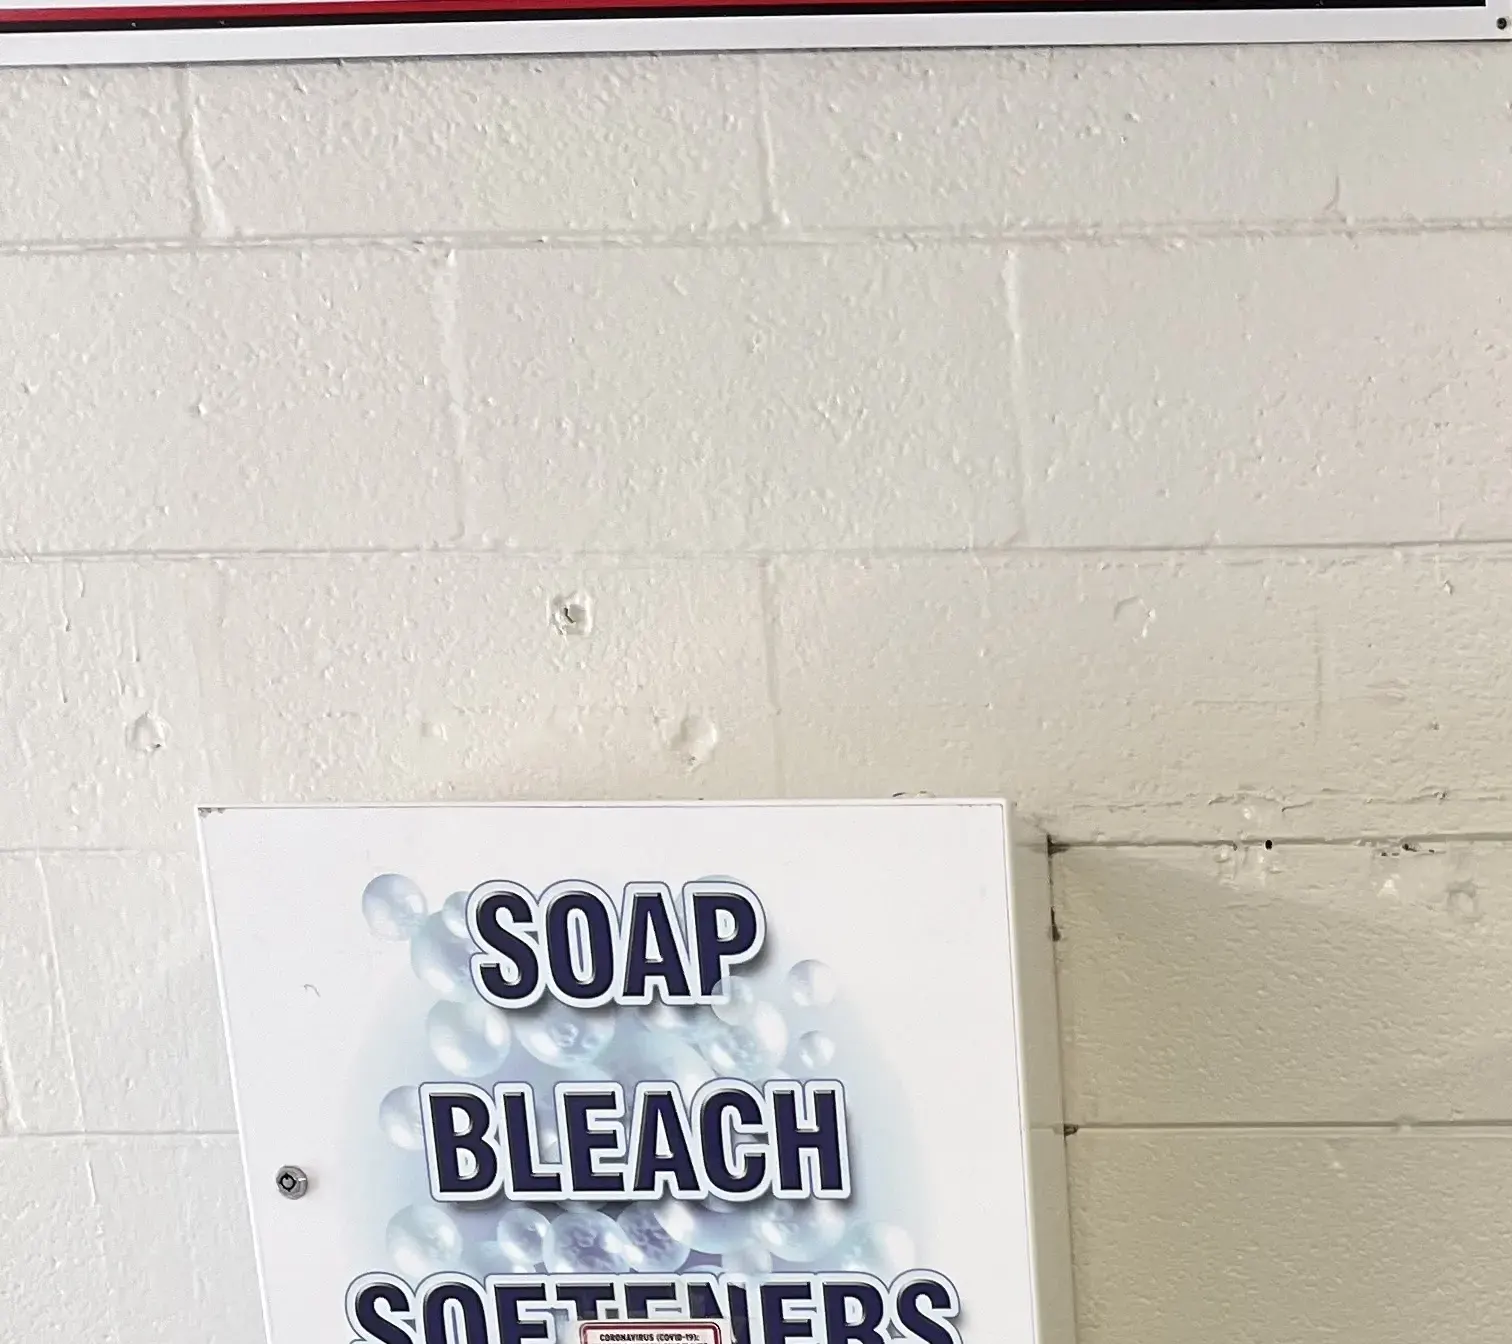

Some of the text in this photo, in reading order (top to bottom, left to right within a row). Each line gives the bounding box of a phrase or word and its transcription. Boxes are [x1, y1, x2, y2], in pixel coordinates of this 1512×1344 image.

[472, 886, 760, 1004] SOAP
[424, 1086, 848, 1196] BLEACH
[599, 1333, 654, 1342] CORONAVIRUS
